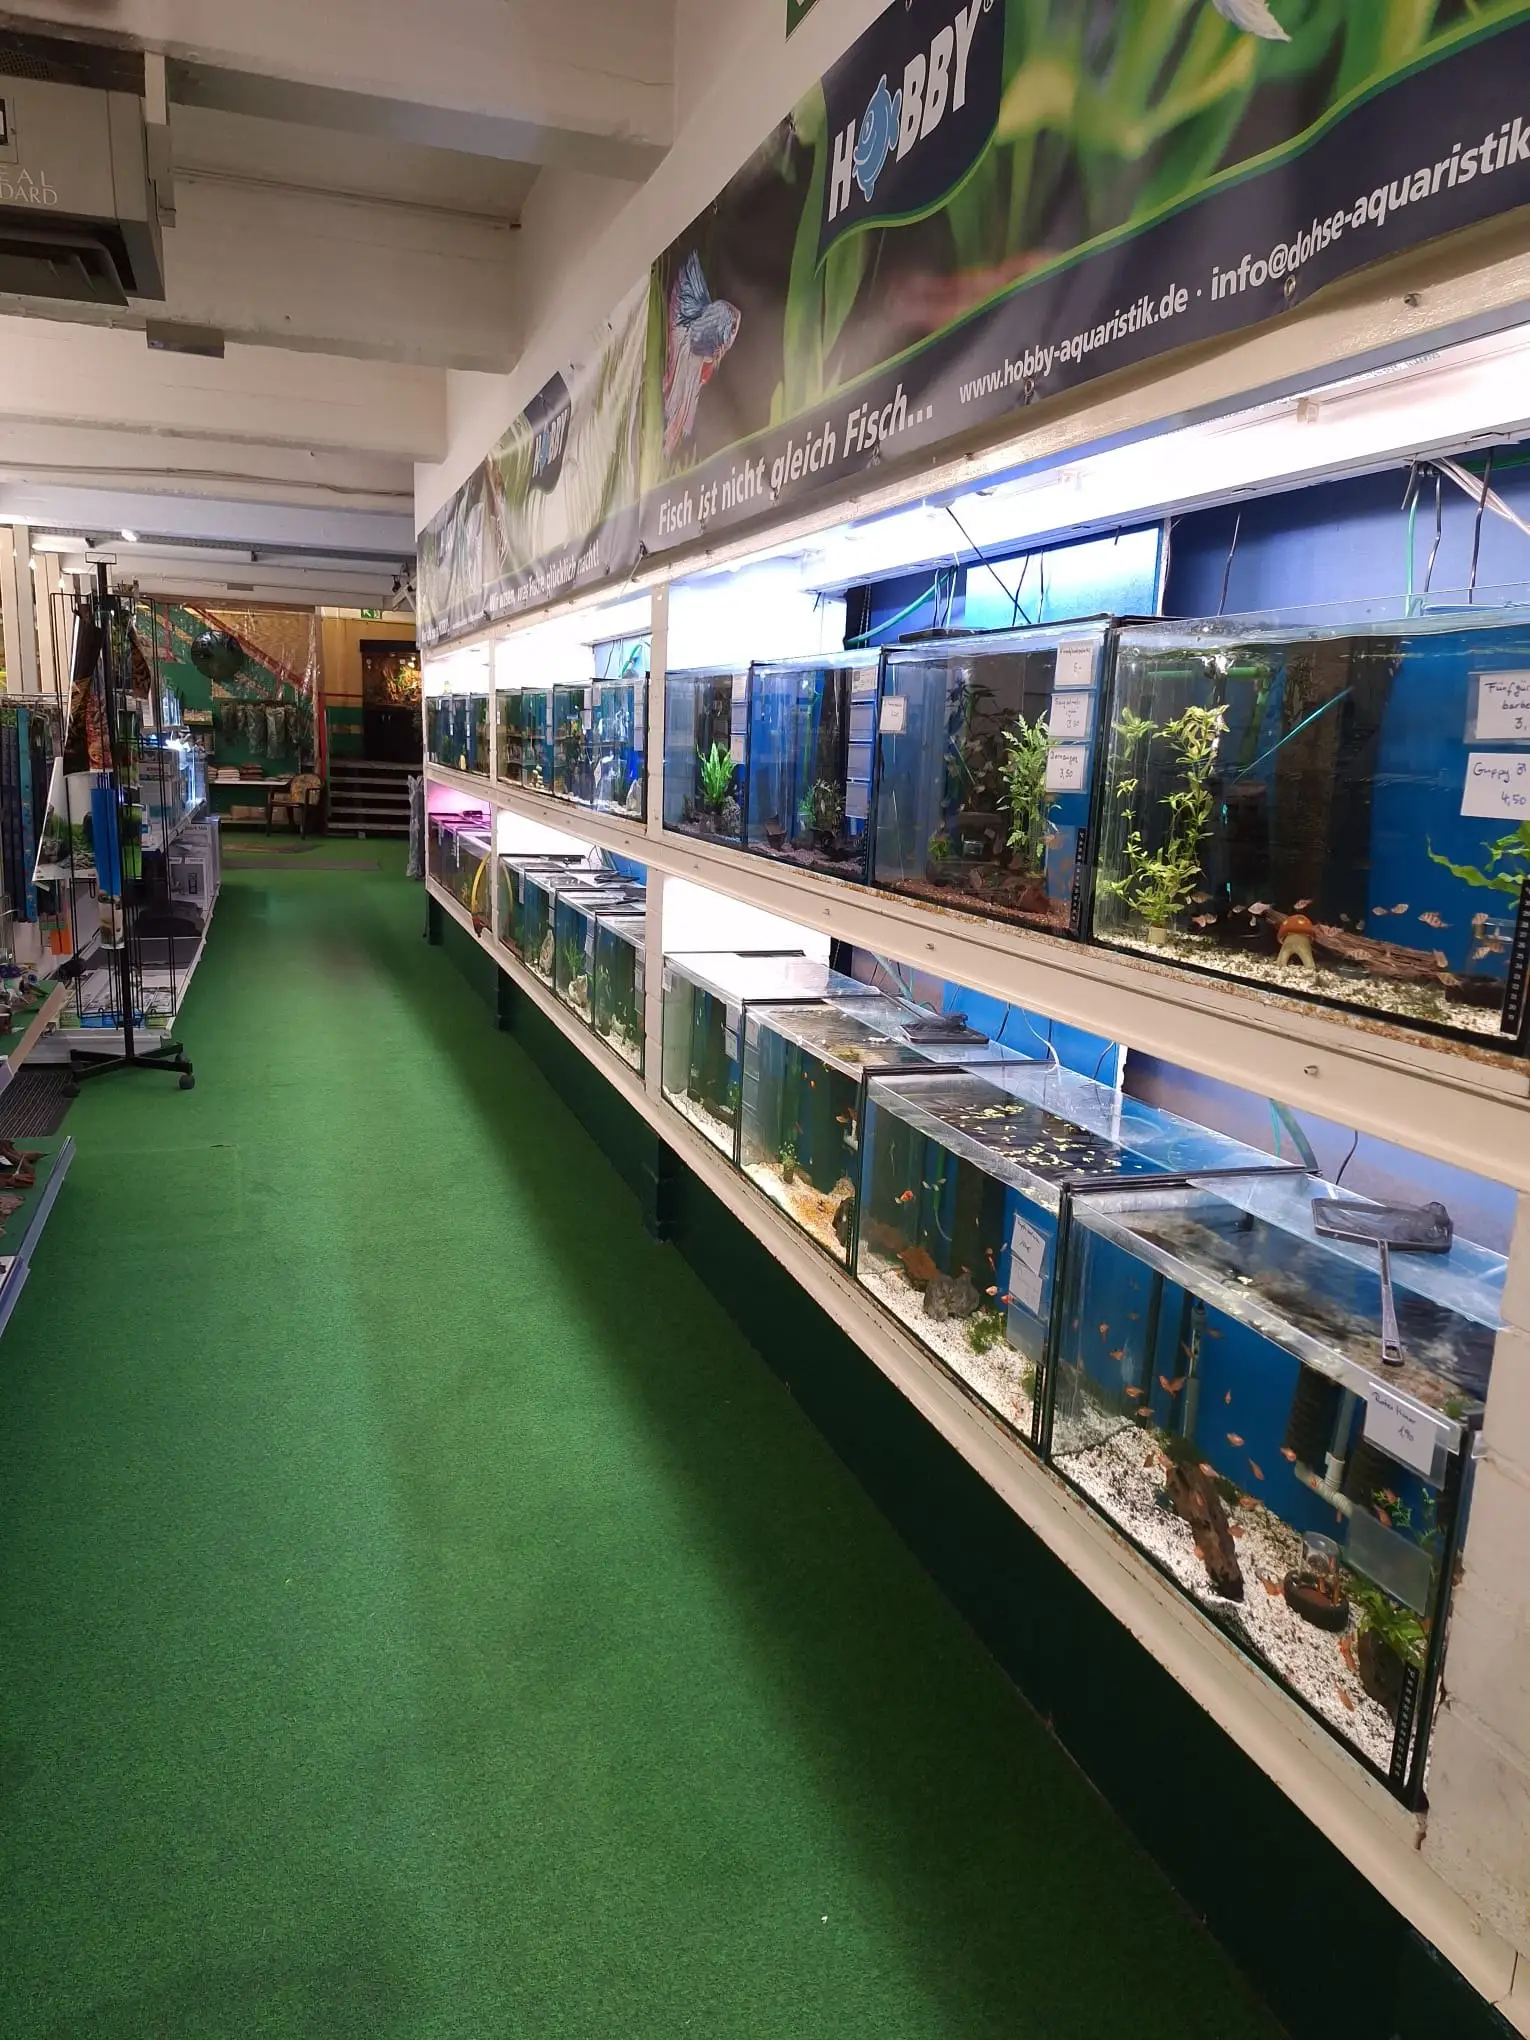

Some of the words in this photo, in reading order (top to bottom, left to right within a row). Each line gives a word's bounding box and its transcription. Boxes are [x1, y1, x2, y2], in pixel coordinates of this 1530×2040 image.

[959, 283, 1189, 404] www.hobby-aquaristik.de
[1211, 117, 1530, 300] info@dohse-aquaristik
[658, 491, 693, 536] Fisch
[698, 480, 717, 520] ist
[722, 456, 766, 511] nicht
[769, 420, 836, 501] gleich
[842, 383, 933, 458] Fisch...
[1474, 762, 1510, 783] Guppy
